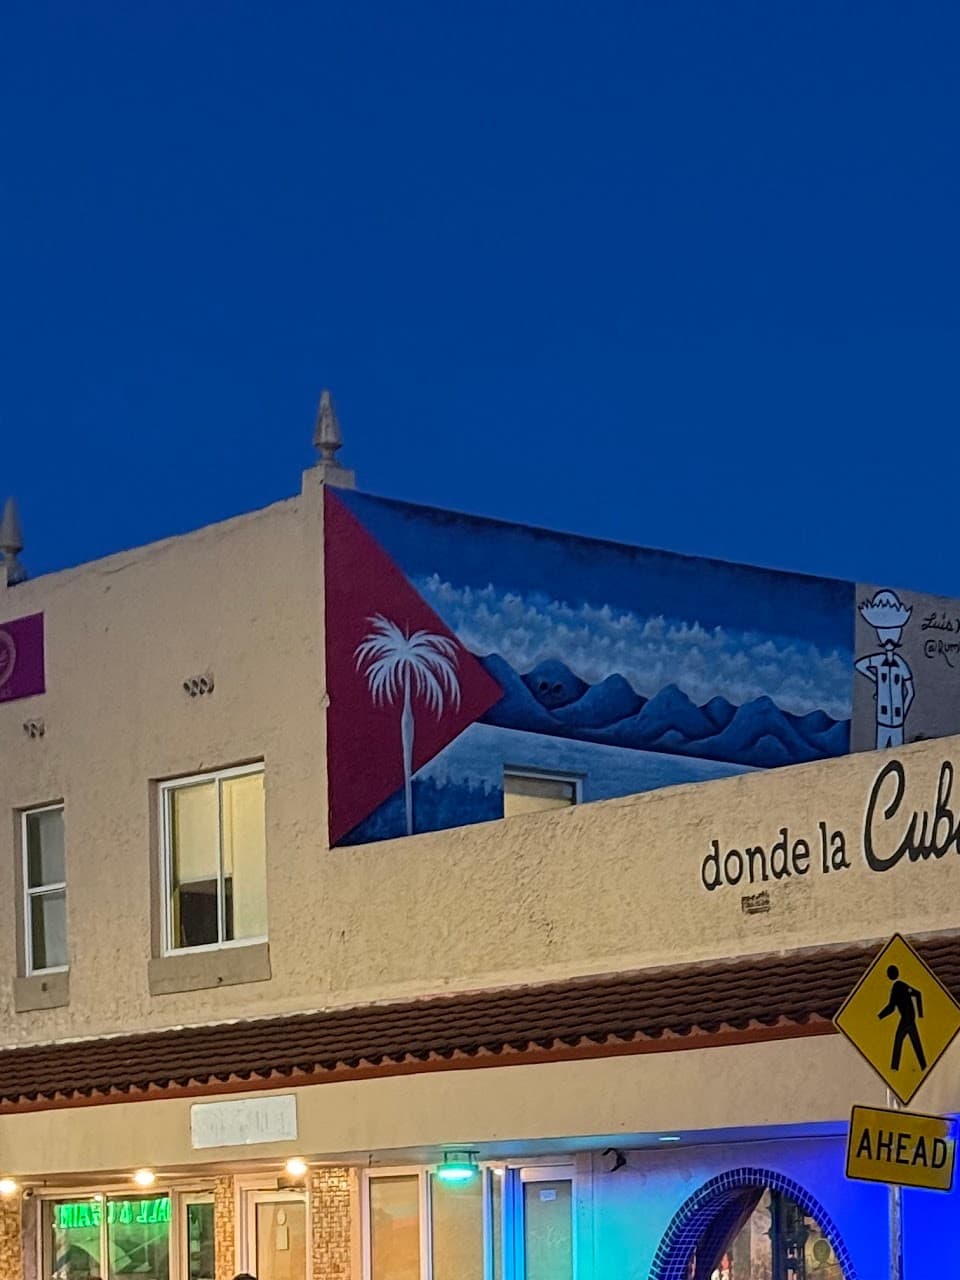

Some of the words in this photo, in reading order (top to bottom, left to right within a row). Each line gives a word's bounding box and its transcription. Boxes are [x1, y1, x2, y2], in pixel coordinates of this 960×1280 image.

[702, 827, 810, 891] donde
[818, 821, 852, 873] la
[856, 1128, 948, 1169] AHEAD
